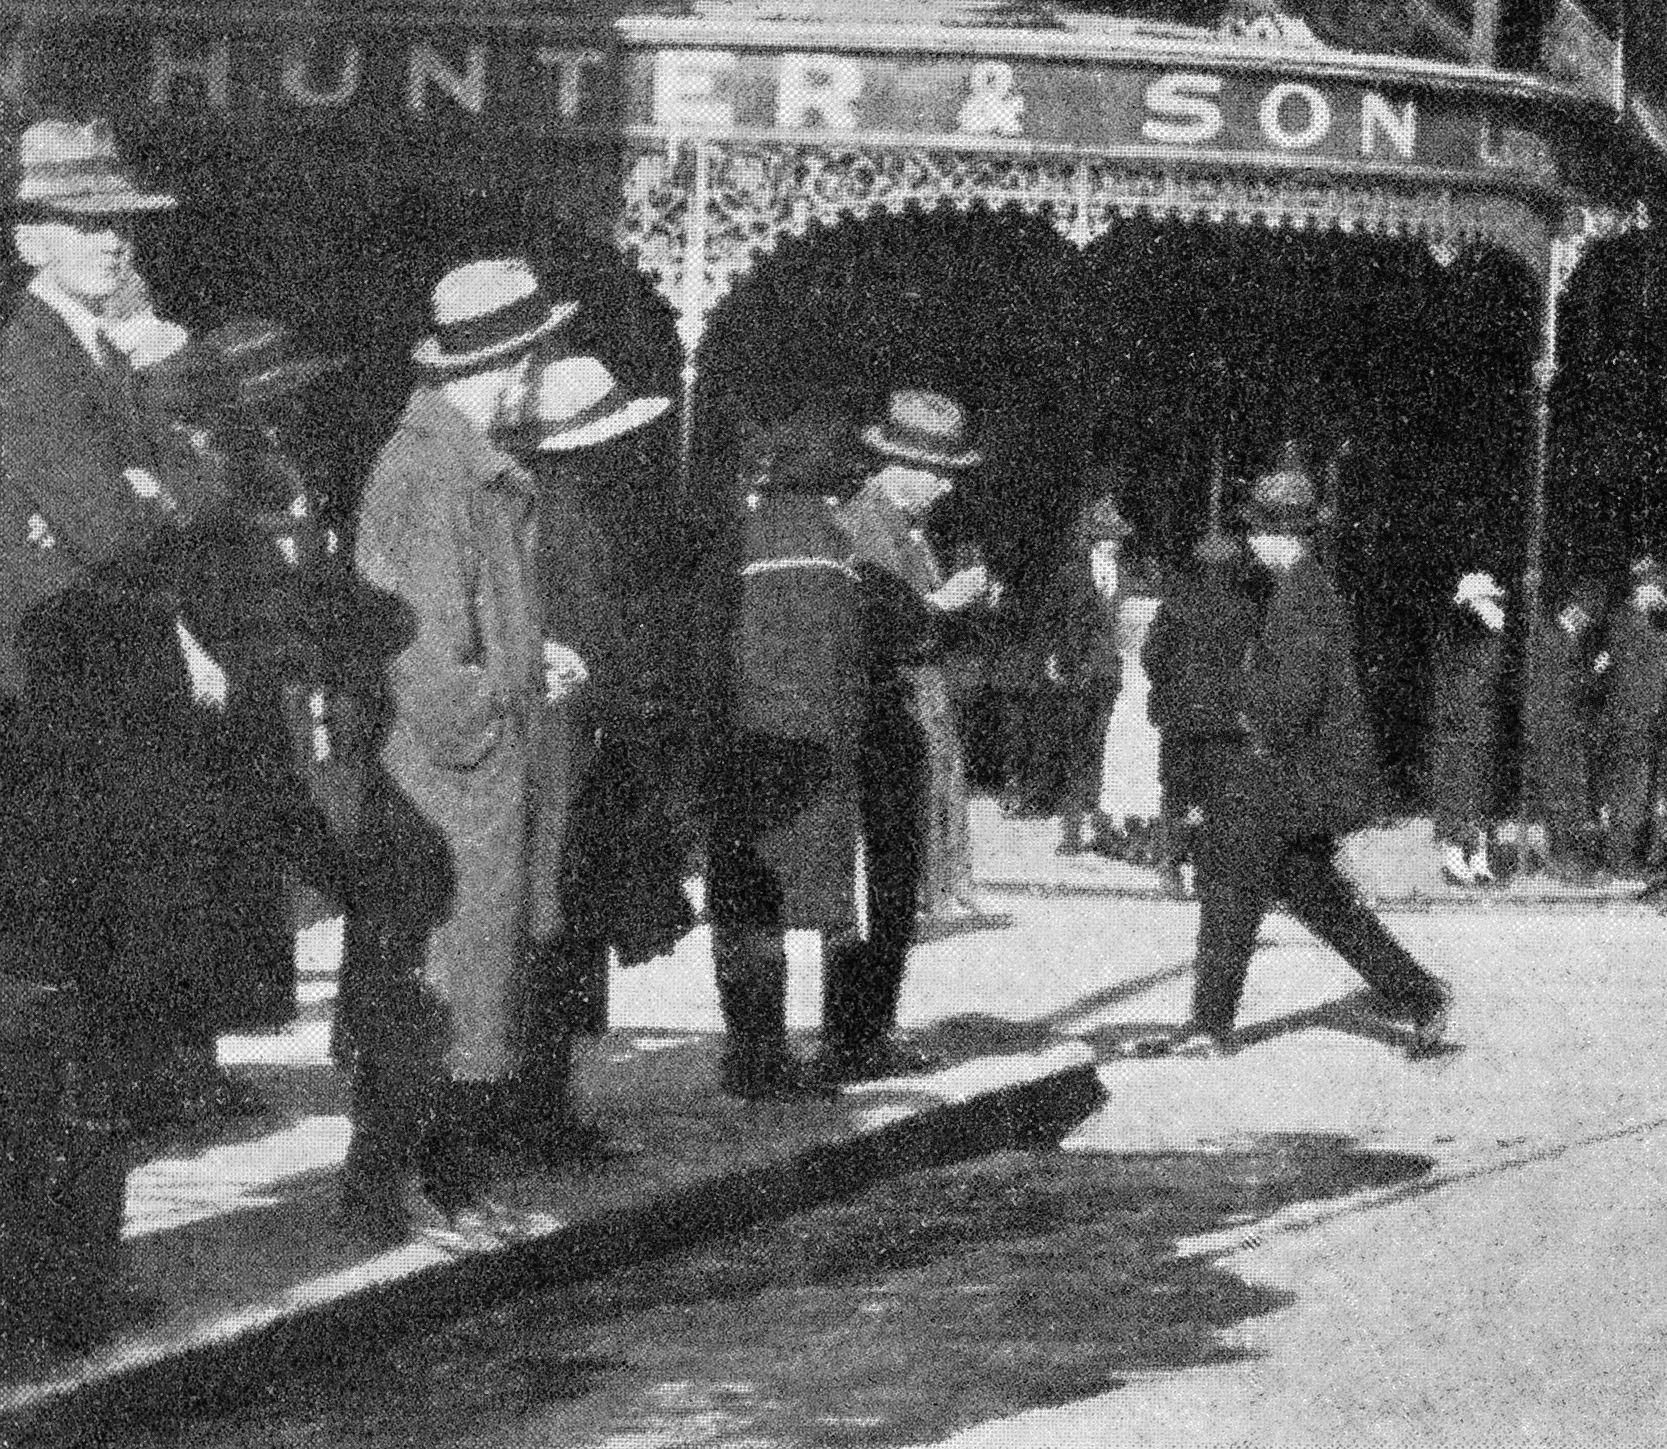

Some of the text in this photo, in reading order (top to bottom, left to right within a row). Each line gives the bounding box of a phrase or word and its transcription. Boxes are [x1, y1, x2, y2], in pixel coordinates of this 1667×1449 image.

[152, 35, 863, 134] HUNTER
[957, 62, 1025, 137] &
[1140, 71, 1419, 158] SON
